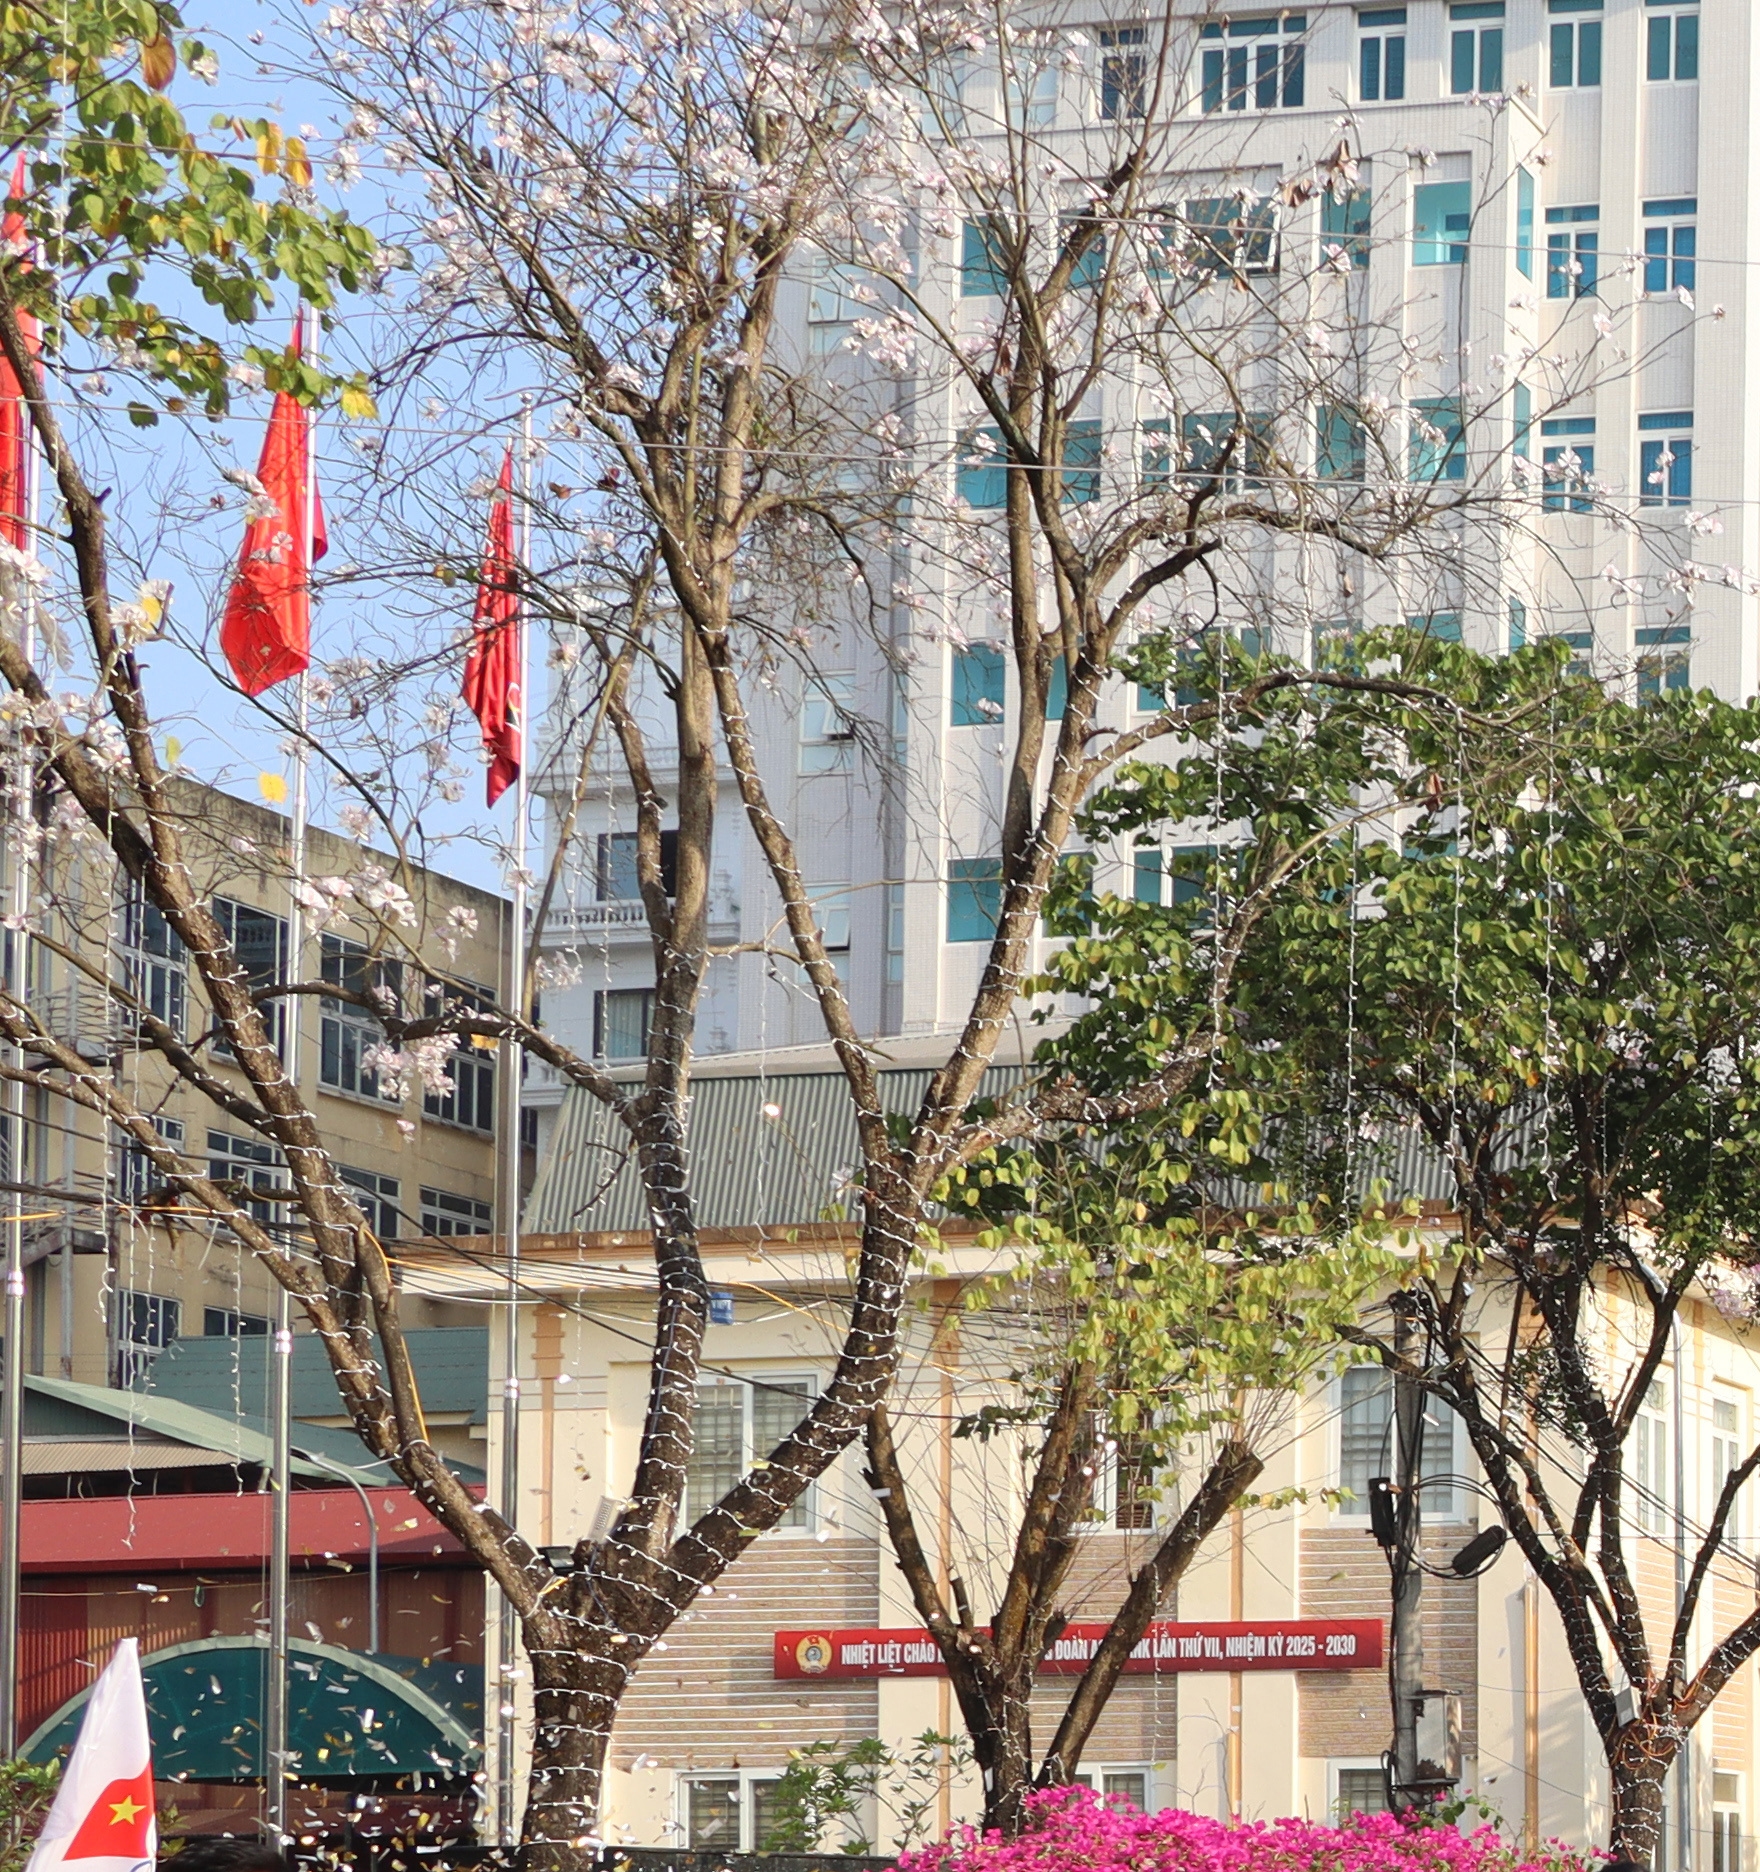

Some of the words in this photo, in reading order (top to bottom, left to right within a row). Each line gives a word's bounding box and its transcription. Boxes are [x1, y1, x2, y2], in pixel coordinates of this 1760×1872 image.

[841, 1639, 877, 1669] NHIỆT
[877, 1638, 902, 1669] LIỆT
[903, 1637, 935, 1664] CHÀO
[1179, 1631, 1203, 1658] THỨ
[1225, 1631, 1266, 1662] NHIỆM
[1267, 1631, 1285, 1657] KỲ
[1285, 1635, 1316, 1657] 2025
[1325, 1634, 1356, 1656] 2030
